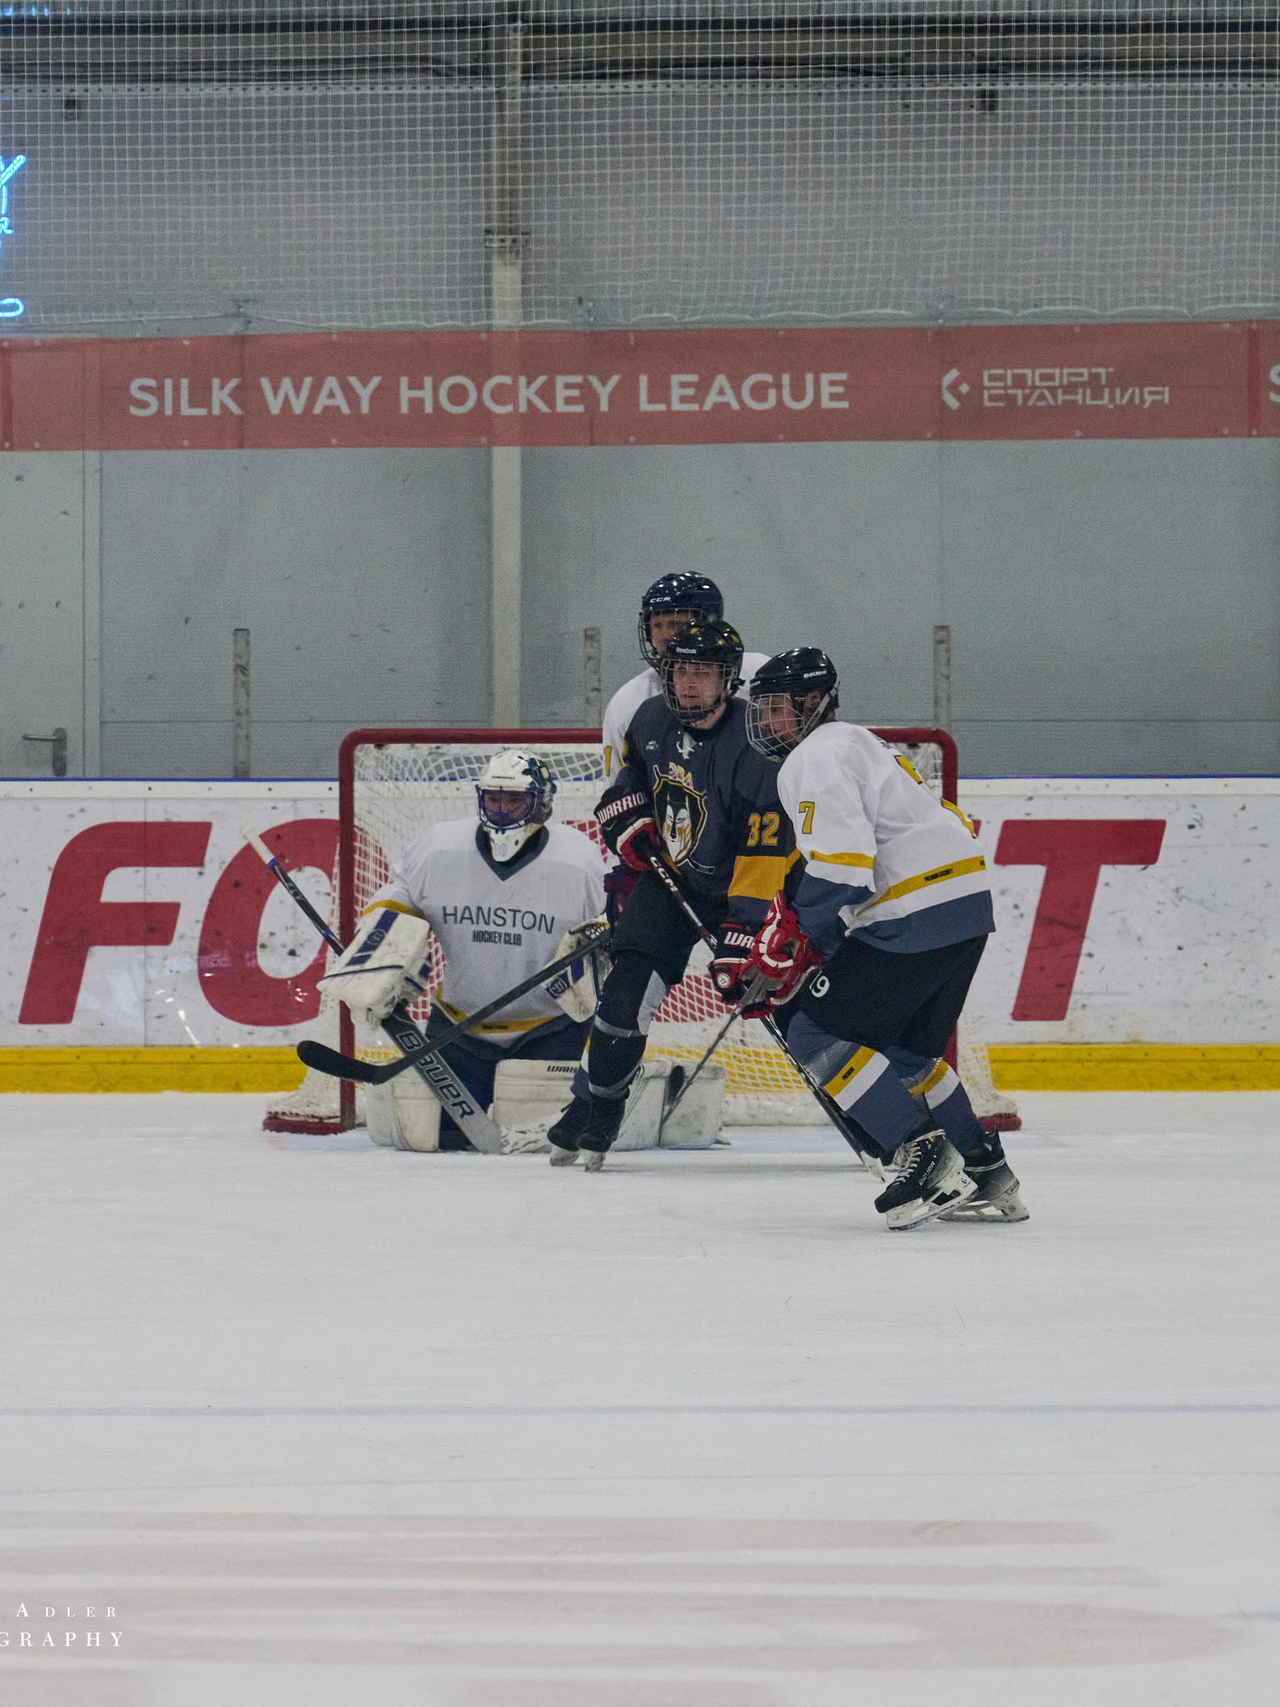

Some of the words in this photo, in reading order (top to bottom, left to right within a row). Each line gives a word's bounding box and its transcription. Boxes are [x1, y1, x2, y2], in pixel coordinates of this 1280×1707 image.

[982, 367, 1114, 387] СПОРТ
[129, 377, 243, 417] SILK
[260, 376, 383, 415] WAY
[399, 374, 621, 414] HOCKEY
[639, 373, 850, 412] LEAGUE
[982, 387, 1169, 408] СТАНЦИЯ
[746, 811, 780, 847] 32
[798, 801, 815, 835] 7
[442, 905, 555, 935] HANSTON
[472, 929, 502, 944] HOCKEY
[503, 931, 523, 946] CLUB
